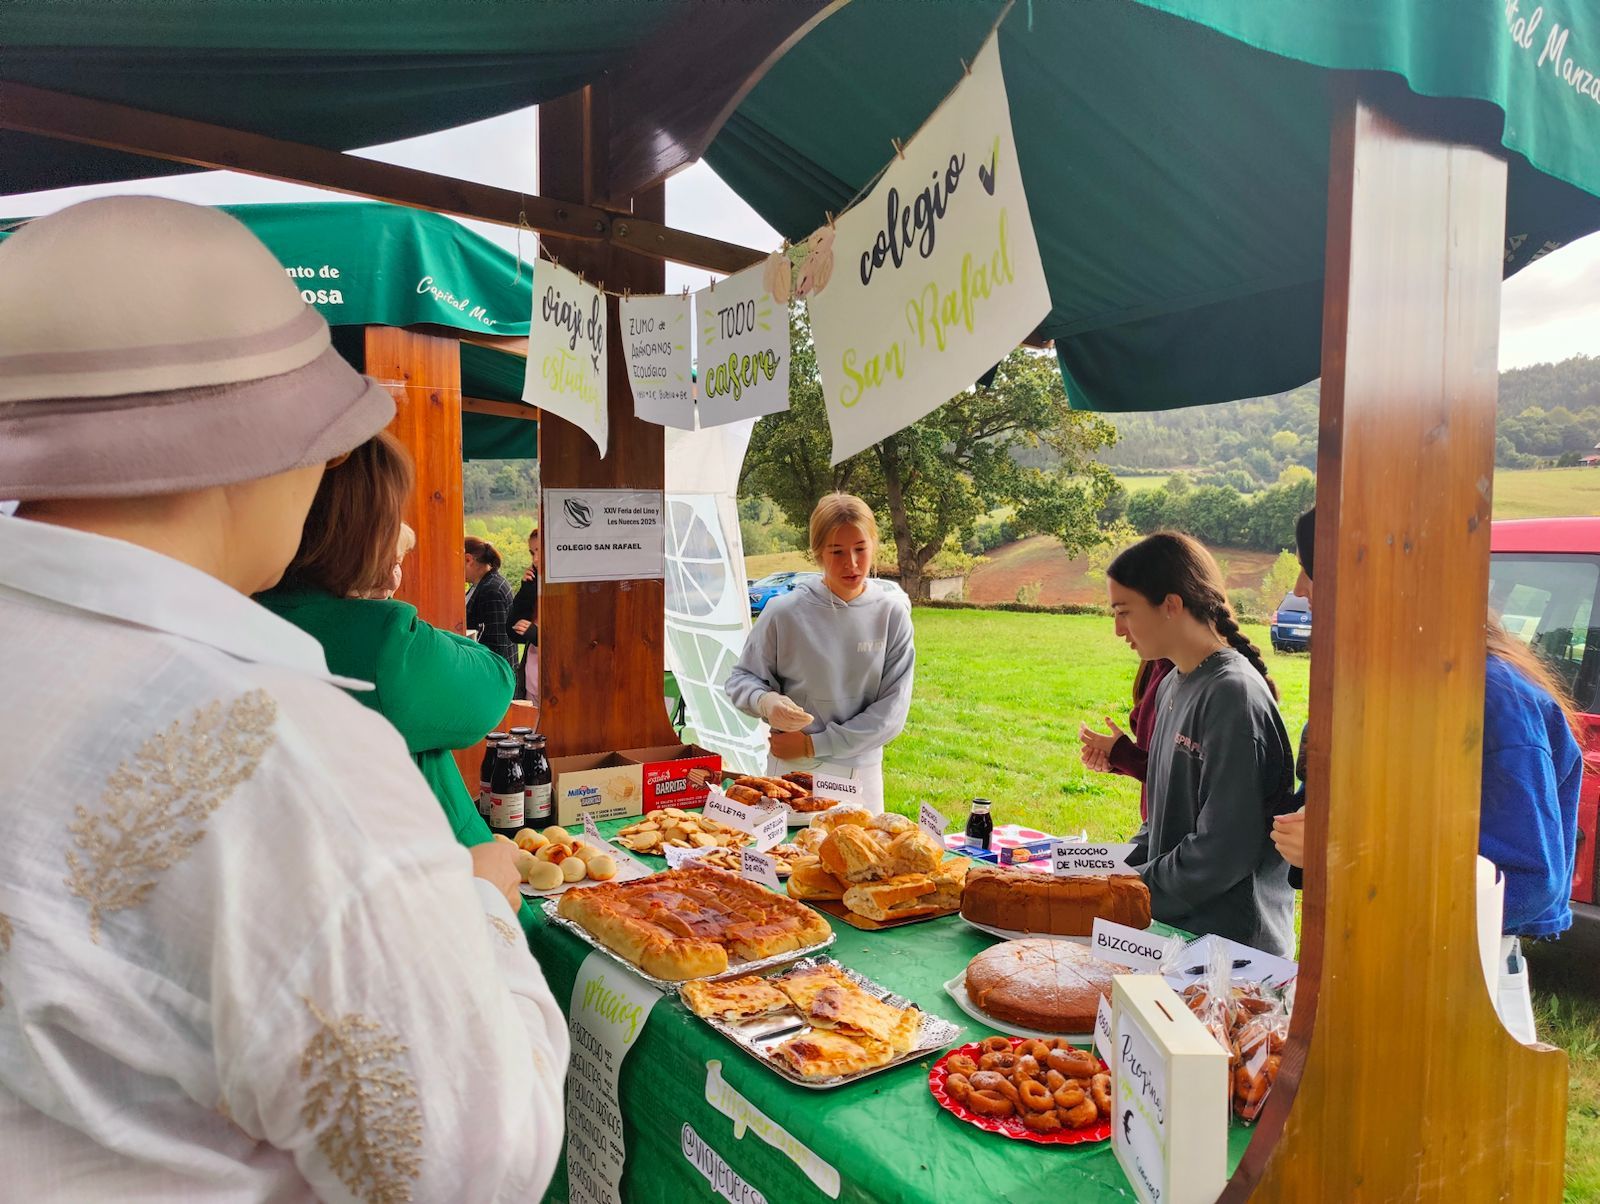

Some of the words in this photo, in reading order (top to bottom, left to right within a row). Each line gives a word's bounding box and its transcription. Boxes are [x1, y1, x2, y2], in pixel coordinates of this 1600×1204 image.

[860, 152, 965, 286] colegio
[319, 265, 340, 278] de
[417, 275, 469, 311] Capital
[840, 338, 907, 408] San
[906, 206, 1015, 352] Rafael
[588, 294, 603, 354] de
[629, 317, 655, 336] ZUMO
[718, 299, 755, 340] TODO
[705, 348, 781, 401] casero
[603, 507, 617, 515] XXIV
[617, 507, 632, 515] Feria
[556, 544, 592, 552] COLEGIO
[612, 543, 642, 551] RAFAEL
[567, 785, 599, 797] Milkybar
[655, 779, 687, 796] BARRITAS
[816, 780, 857, 794] CASADIELLES
[708, 800, 747, 821] GALLETAS
[1057, 848, 1108, 856] BIZCOCHO
[1056, 861, 1070, 870] DE
[1074, 859, 1115, 869] NUECES
[1097, 933, 1163, 960] BIZCOCHO
[683, 1123, 766, 1204] @viajedees
